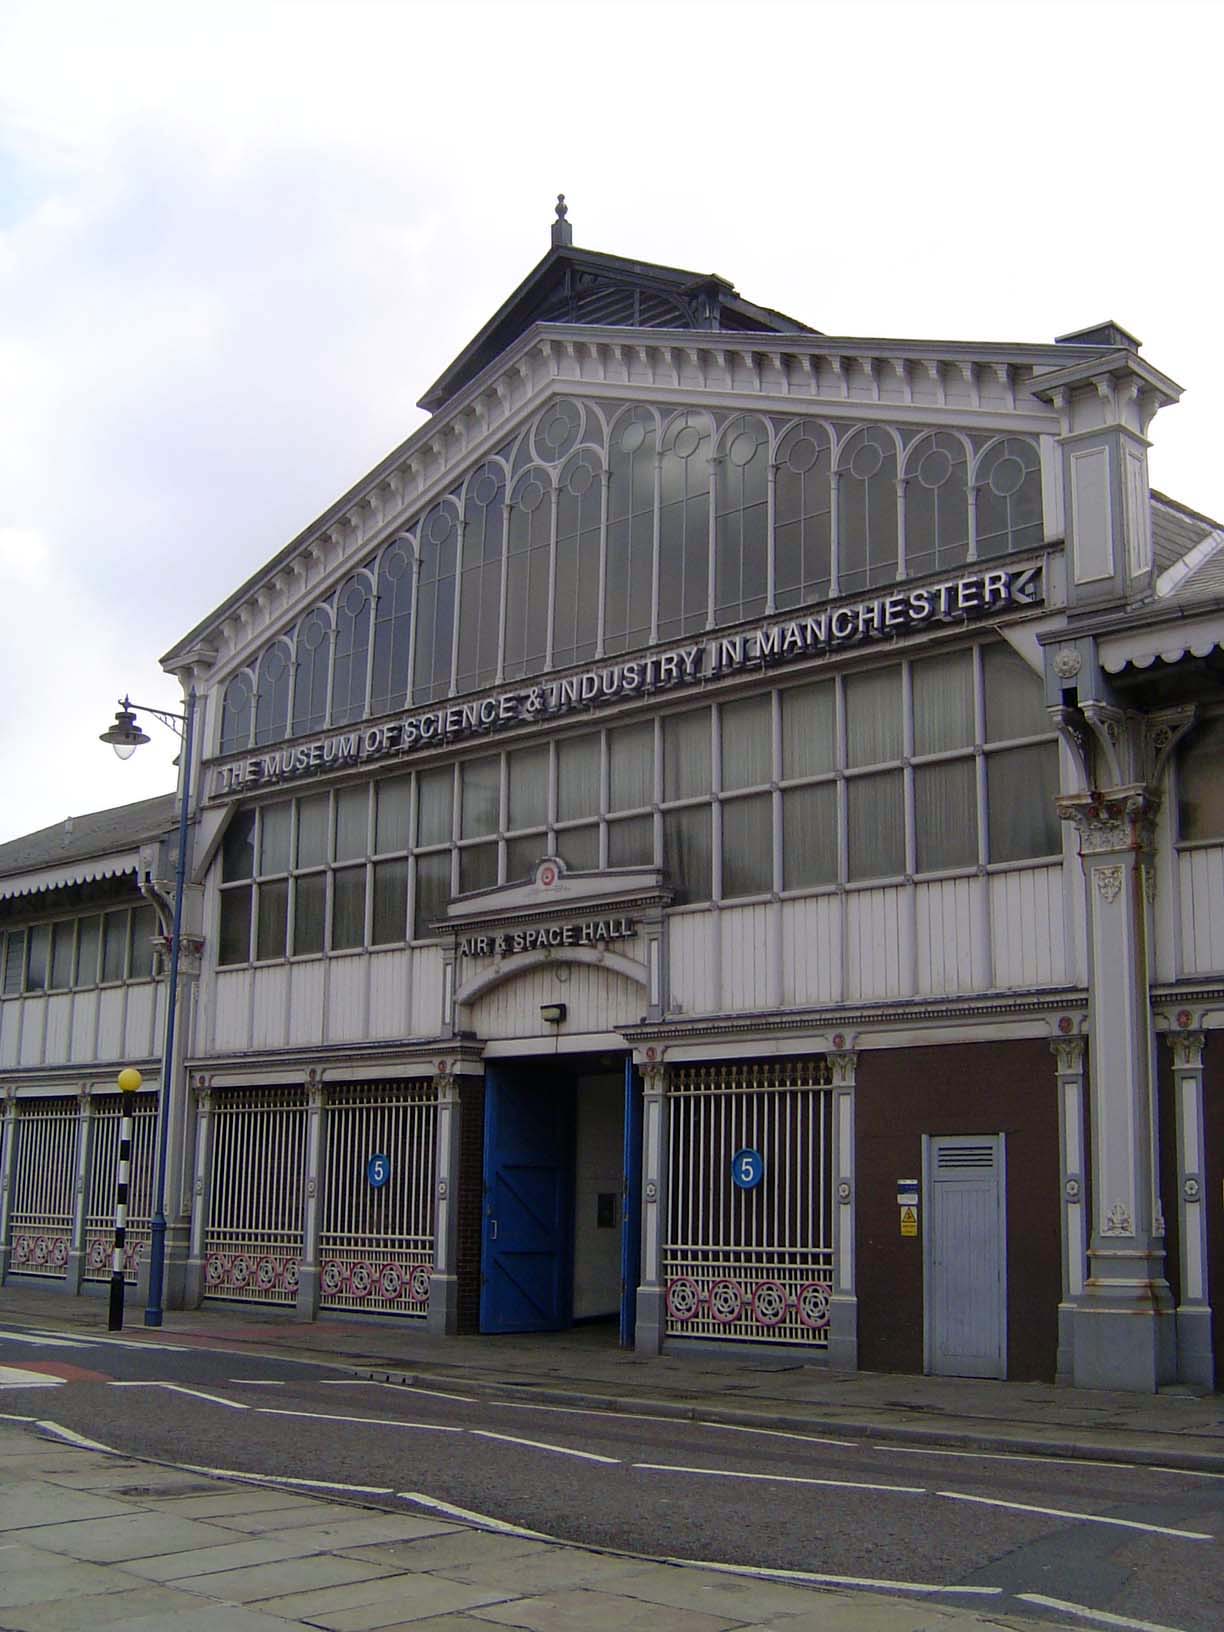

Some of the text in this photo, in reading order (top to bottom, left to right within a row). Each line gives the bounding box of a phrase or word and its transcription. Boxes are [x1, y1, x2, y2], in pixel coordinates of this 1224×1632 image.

[222, 570, 1010, 788] THE MUSEUM OF SCIENCE & INDUSTRY IN MANCHESTER
[460, 936, 487, 955] AIR
[513, 925, 574, 949] SPACE
[582, 918, 632, 939] HALL
[374, 1161, 384, 1181] 5
[741, 1158, 754, 1181] 5
